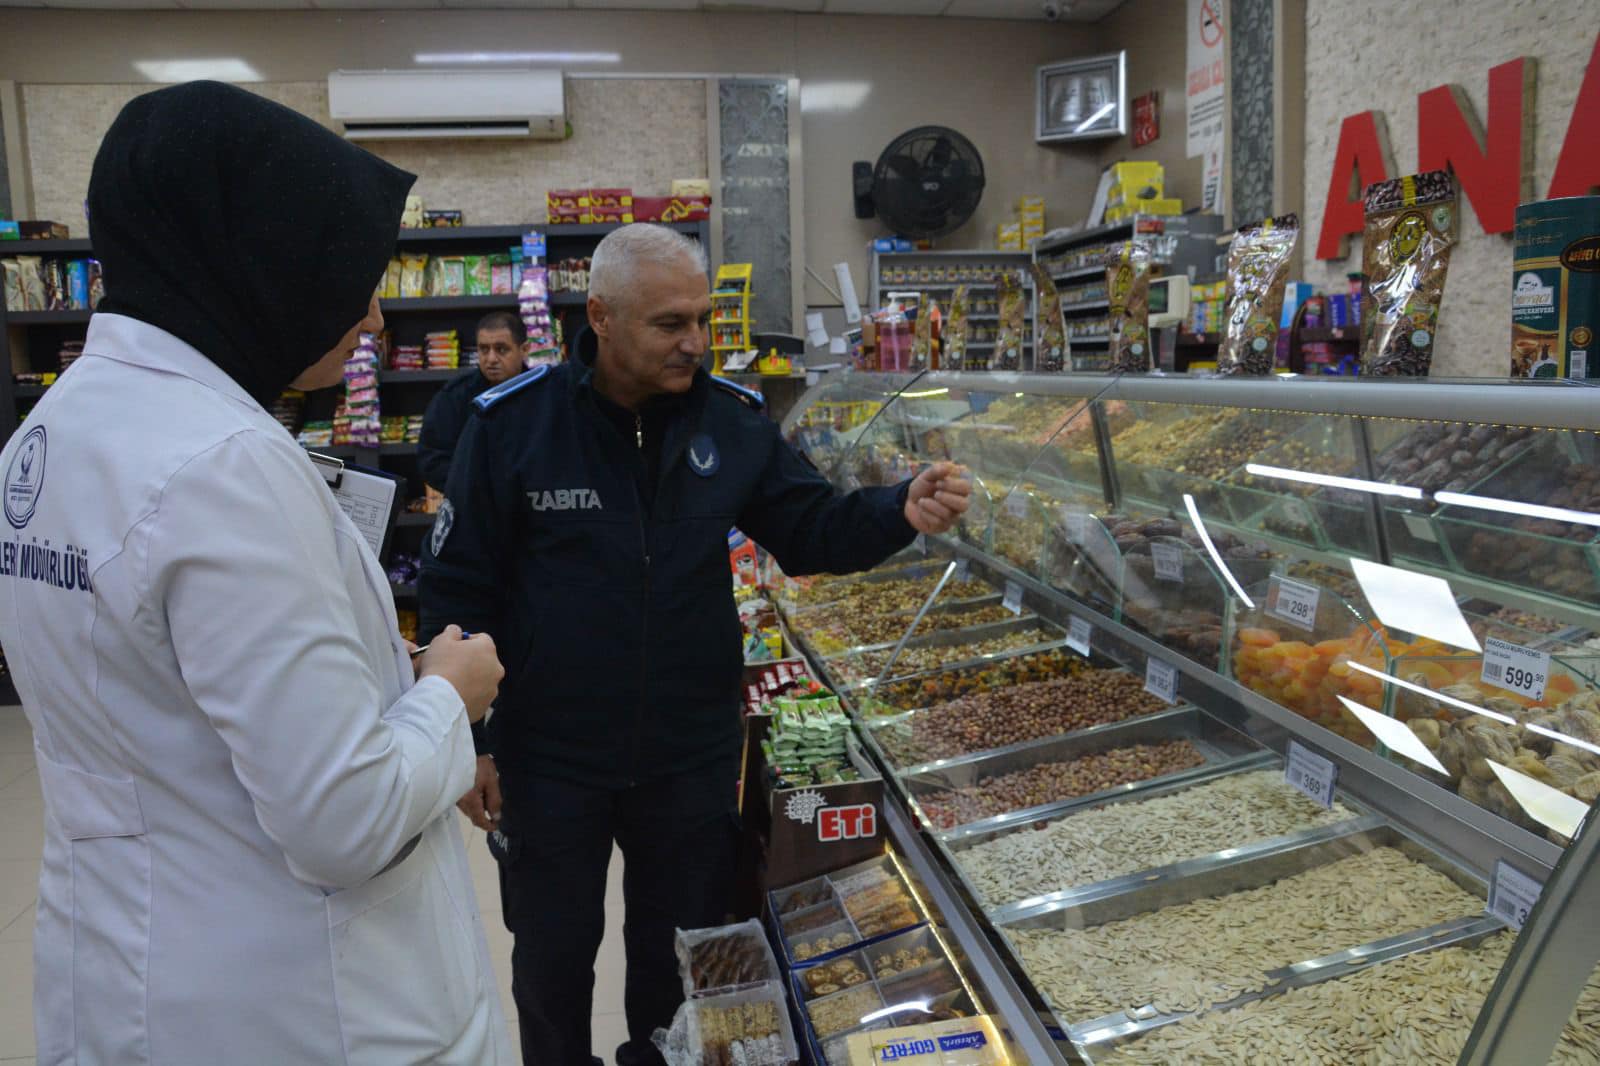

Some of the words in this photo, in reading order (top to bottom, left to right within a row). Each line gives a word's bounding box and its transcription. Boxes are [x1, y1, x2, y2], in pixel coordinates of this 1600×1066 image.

[526, 488, 602, 511] ZABITA
[1290, 600, 1309, 618] 298
[881, 1038, 936, 1060] GOFRET
